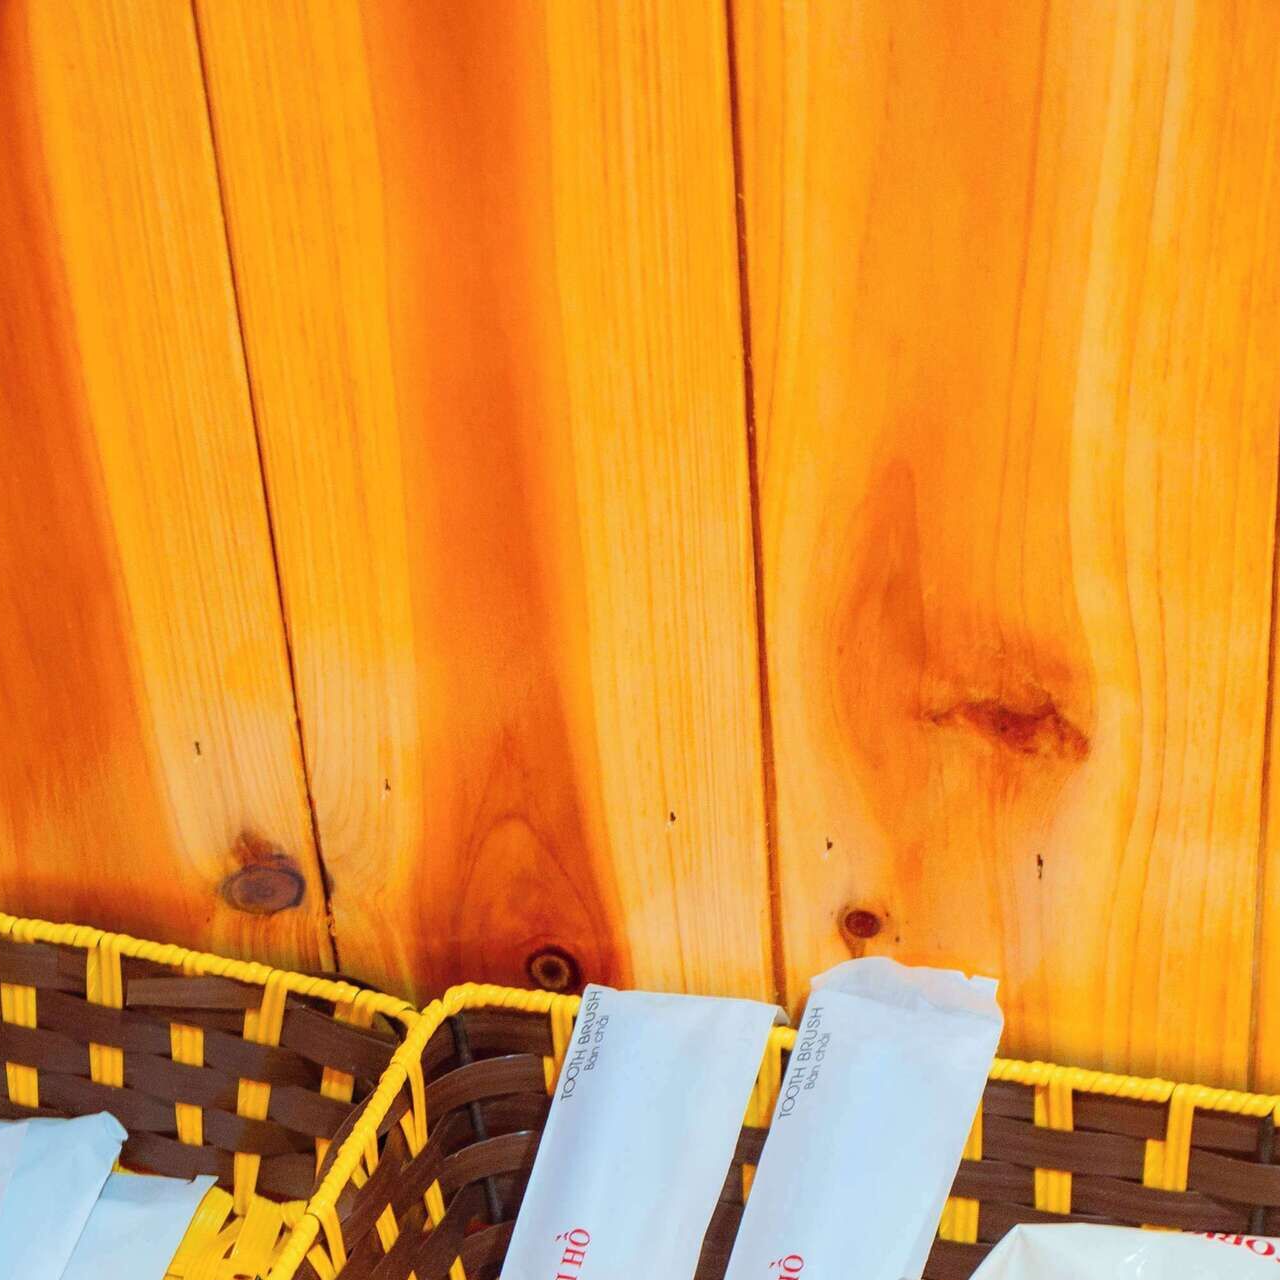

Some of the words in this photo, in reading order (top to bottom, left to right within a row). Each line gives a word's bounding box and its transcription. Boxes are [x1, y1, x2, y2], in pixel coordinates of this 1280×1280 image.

[560, 1050, 587, 1101] TOOTH
[578, 991, 602, 1045] BRUSH
[778, 1067, 806, 1120] TOOTH
[797, 1007, 824, 1062] BRUSH
[555, 1227, 593, 1270] HỒ
